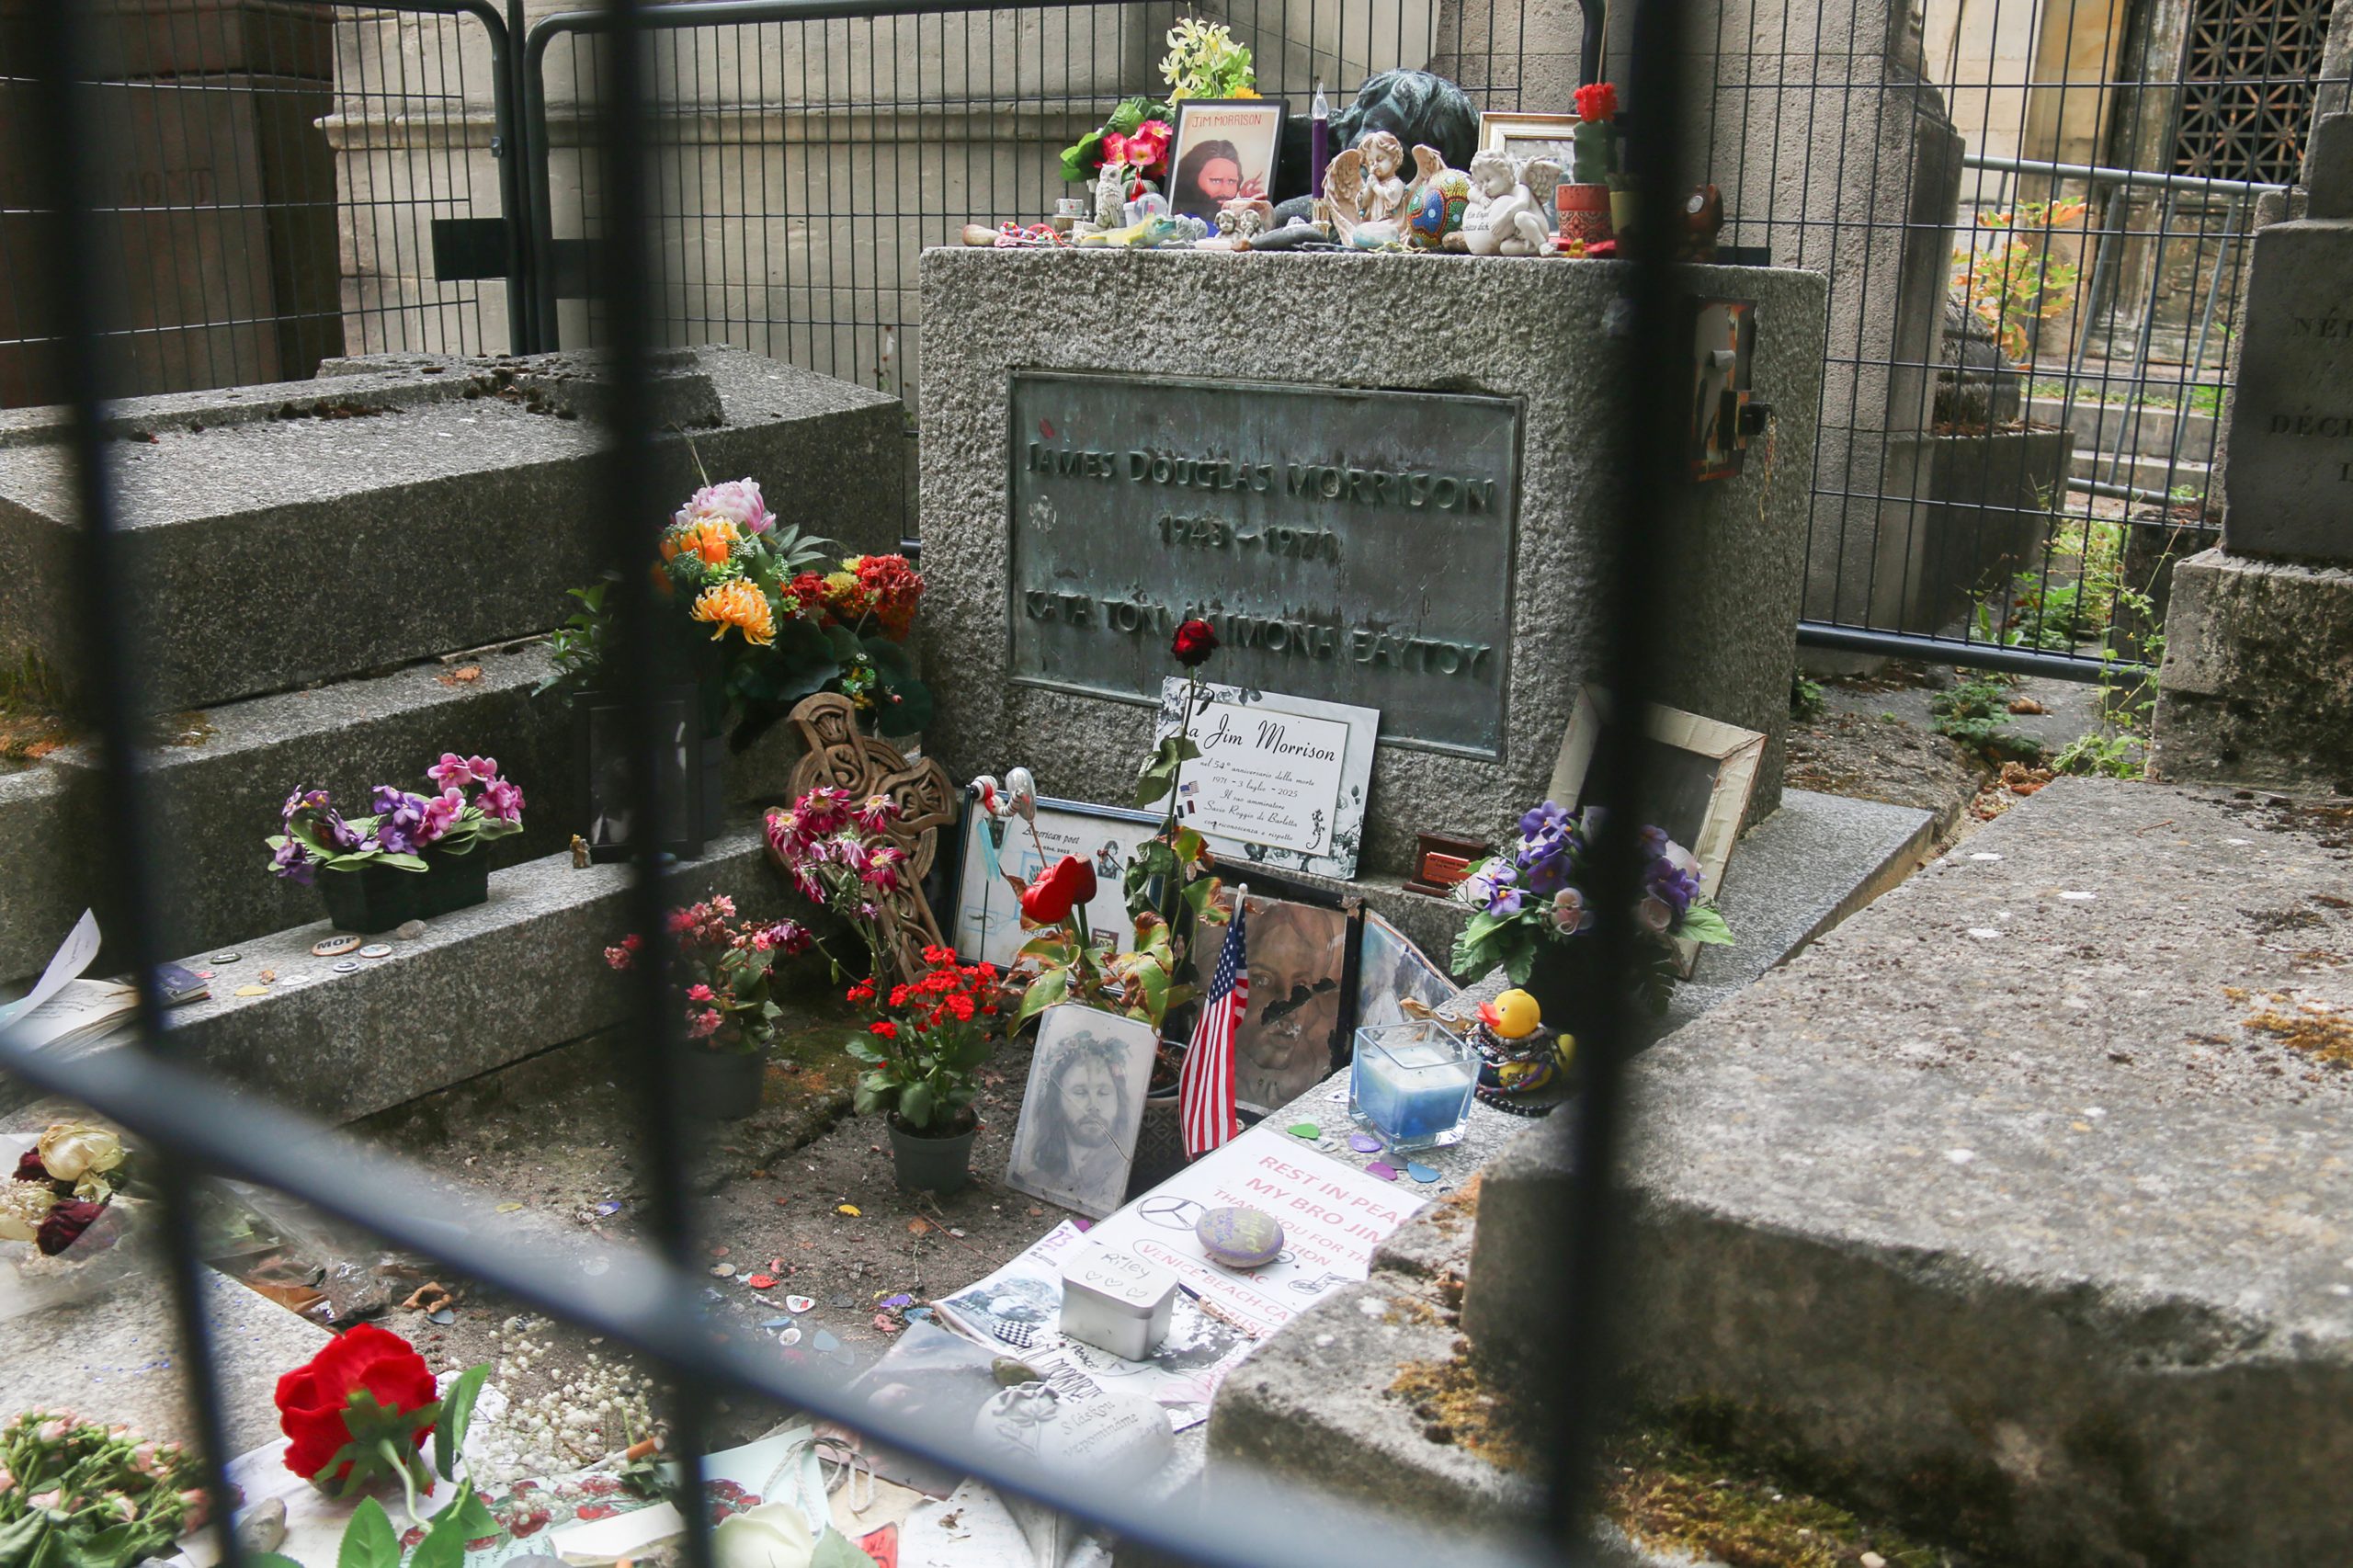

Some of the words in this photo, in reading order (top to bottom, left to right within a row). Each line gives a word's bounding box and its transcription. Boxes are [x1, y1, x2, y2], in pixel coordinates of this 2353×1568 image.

[1191, 116, 1211, 128] JIM
[1214, 114, 1263, 127] MORRISON
[1026, 440, 1116, 477] JAMES
[1129, 449, 1273, 492] DOUGLAS
[1287, 462, 1495, 515] MORRISON
[1203, 713, 1243, 749] Jim
[1256, 720, 1336, 762] Morrison
[1213, 776, 1227, 784] 1971
[1246, 779, 1266, 792] luglio
[1278, 788, 1298, 798] 2025
[1232, 767, 1272, 779] anniversario
[1275, 771, 1292, 782] della
[1296, 778, 1314, 787] morte
[1246, 799, 1285, 810] ammiratore
[1267, 812, 1298, 827] Barletta
[1063, 835, 1080, 845] poet
[1218, 823, 1258, 835] riconoscenza
[1268, 832, 1293, 841] rispetto
[316, 937, 357, 949] MOP
[1258, 1155, 1320, 1185] REST
[1318, 1182, 1349, 1200] IN
[1245, 1177, 1290, 1200] MY
[1289, 1197, 1344, 1225] BRO
[1274, 1215, 1308, 1235] YOU
[1308, 1233, 1342, 1253] FOR
[1101, 1253, 1150, 1279] Riley
[1142, 1244, 1200, 1278] VENICE
